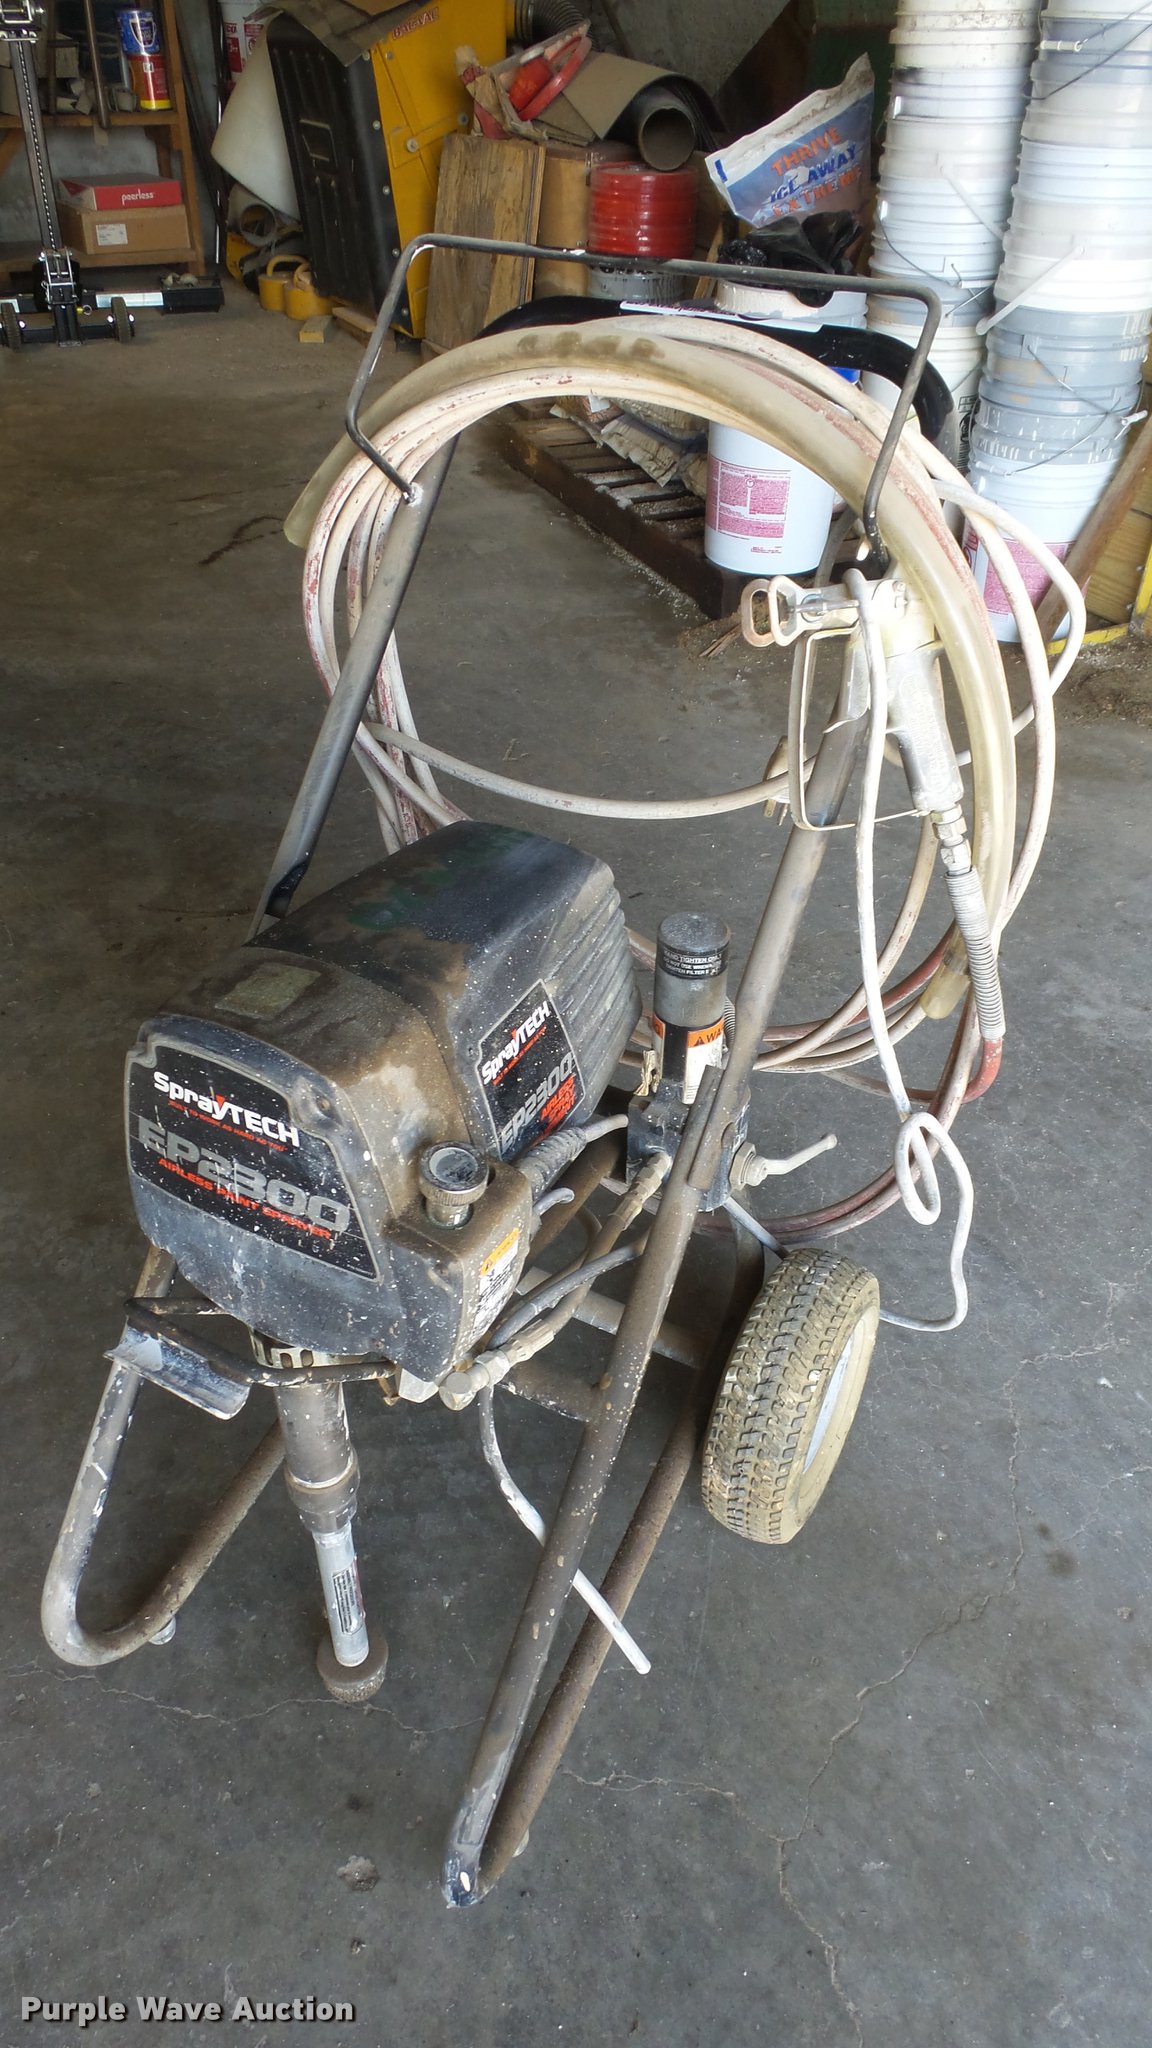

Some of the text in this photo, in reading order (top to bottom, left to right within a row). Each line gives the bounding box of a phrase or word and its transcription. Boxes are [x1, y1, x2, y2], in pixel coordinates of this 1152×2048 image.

[771, 126, 841, 176] THRIVE
[807, 143, 857, 184] AWAY
[121, 188, 154, 206] peerless
[482, 1001, 551, 1085] SprayTECH
[153, 1071, 300, 1147] SprayTECH
[501, 1051, 576, 1147] EP2300
[138, 1115, 351, 1233] EP2300
[158, 1157, 214, 1191] AIRLESS
[216, 1186, 259, 1211] PAINT
